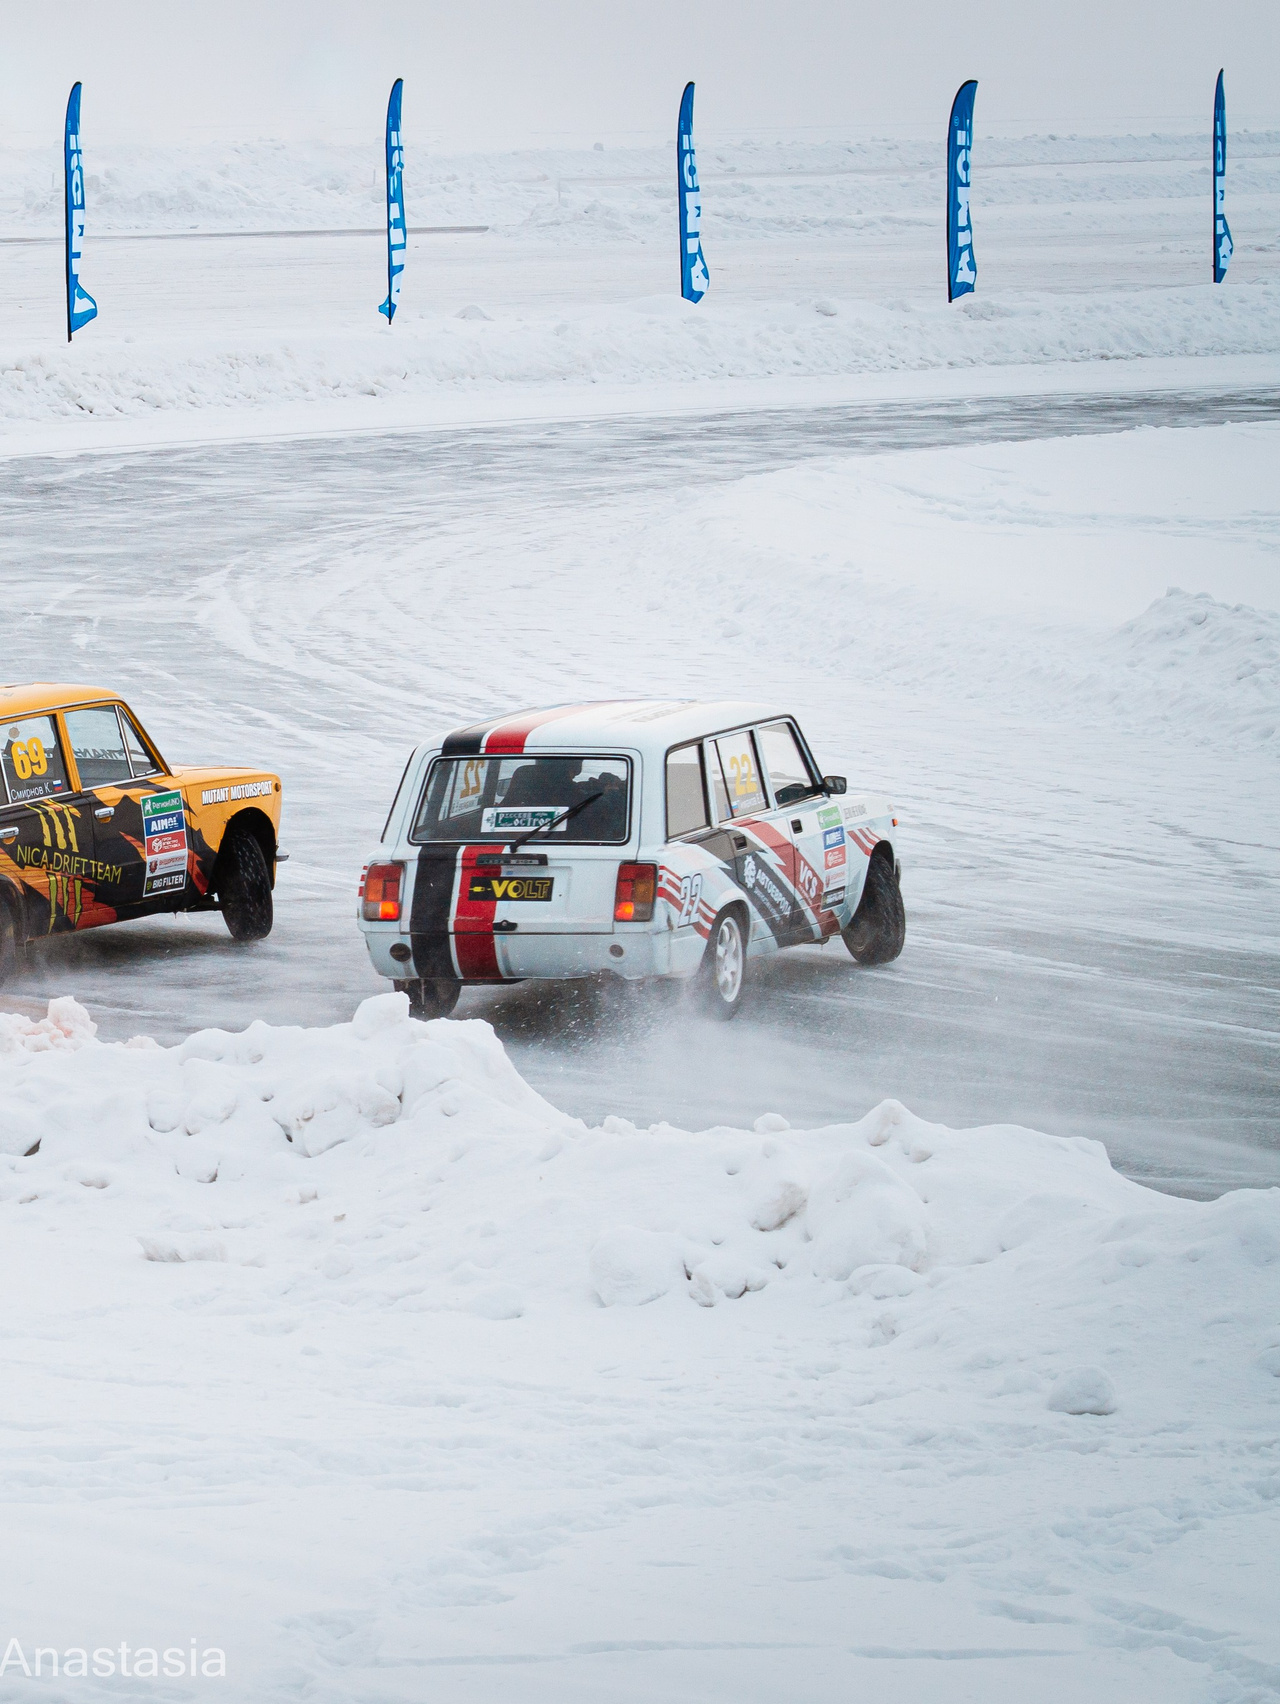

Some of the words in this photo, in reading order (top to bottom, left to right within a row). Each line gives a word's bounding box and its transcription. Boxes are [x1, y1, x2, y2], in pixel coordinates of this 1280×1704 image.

[956, 119, 976, 284] AIMOL
[11, 737, 48, 780] 69
[730, 753, 757, 796] 22
[11, 785, 44, 801] Смирнов
[202, 786, 229, 806] MUTANT
[230, 780, 272, 801] MOTORSPORT
[16, 844, 49, 869] NICA
[53, 852, 88, 876] DRIFT
[90, 860, 122, 884] TEAM
[152, 878, 163, 889] BIG
[163, 874, 184, 887] FILTER
[800, 860, 818, 899] VCS
[491, 880, 551, 899] VOLT
[677, 873, 703, 928] 22
